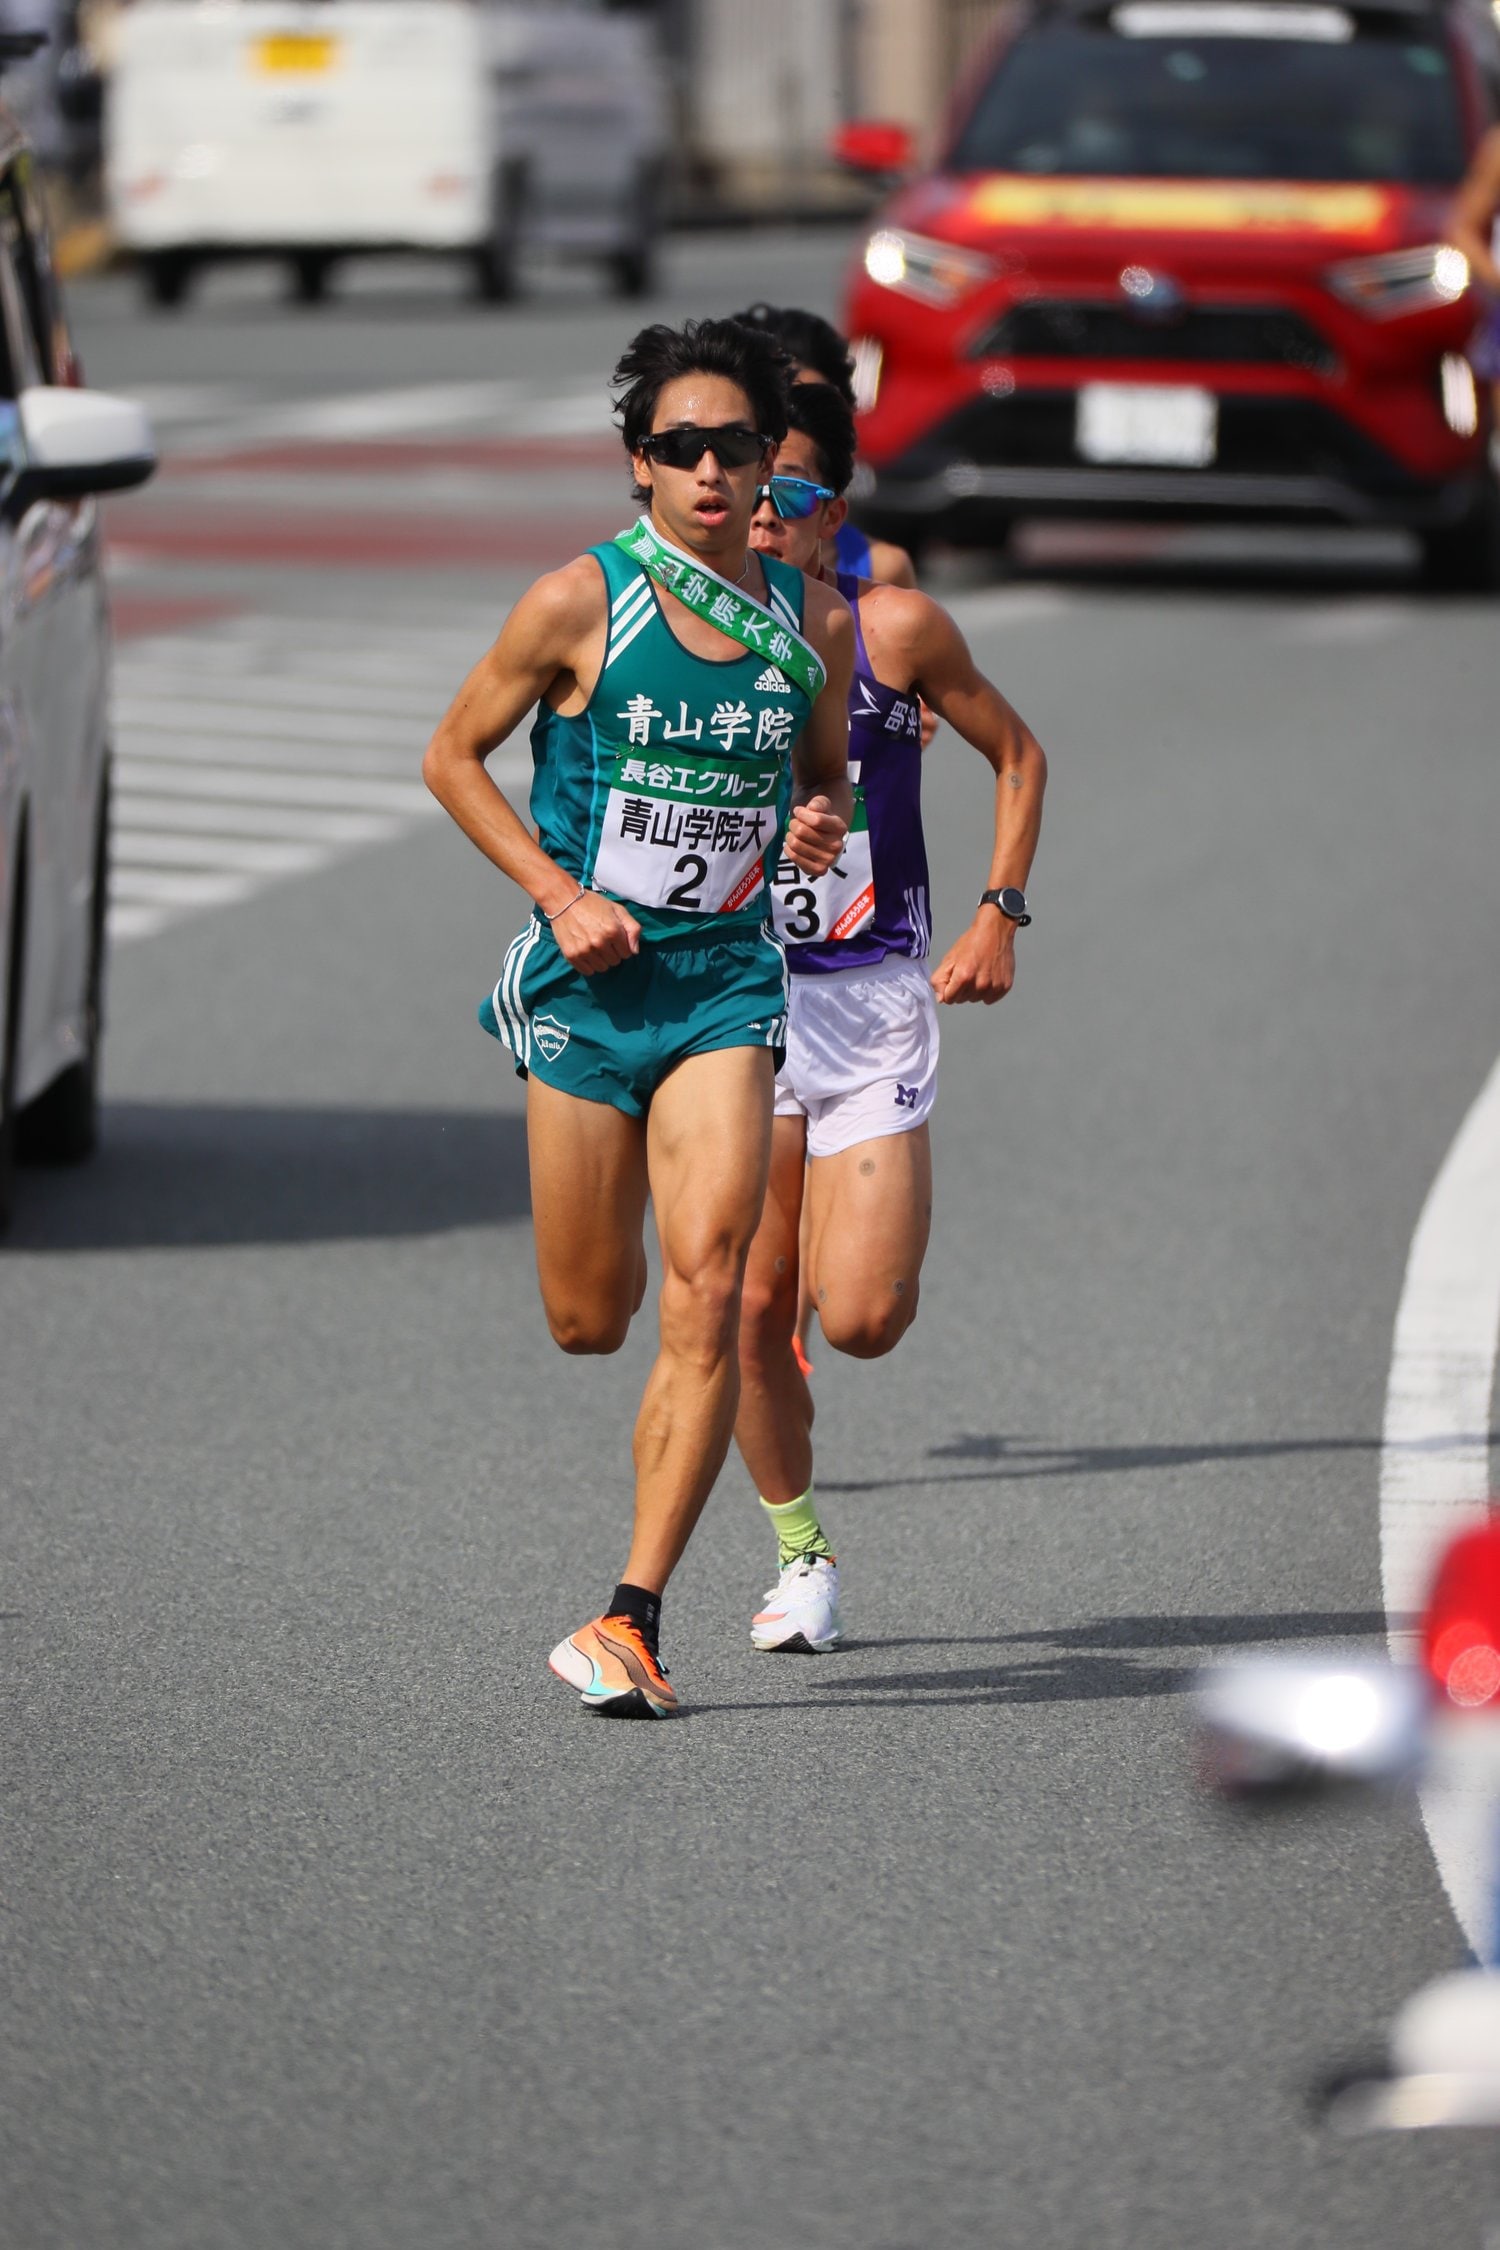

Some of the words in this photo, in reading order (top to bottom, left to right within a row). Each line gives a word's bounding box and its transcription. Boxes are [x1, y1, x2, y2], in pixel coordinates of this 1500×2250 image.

[754, 680, 791, 693] adidas
[616, 693, 794, 751] 青山学院
[620, 758, 778, 798] 長谷工グループ
[620, 798, 766, 852] 青山学院大
[666, 854, 708, 908] 2
[784, 888, 820, 939] 3
[895, 1083, 918, 1109] M
